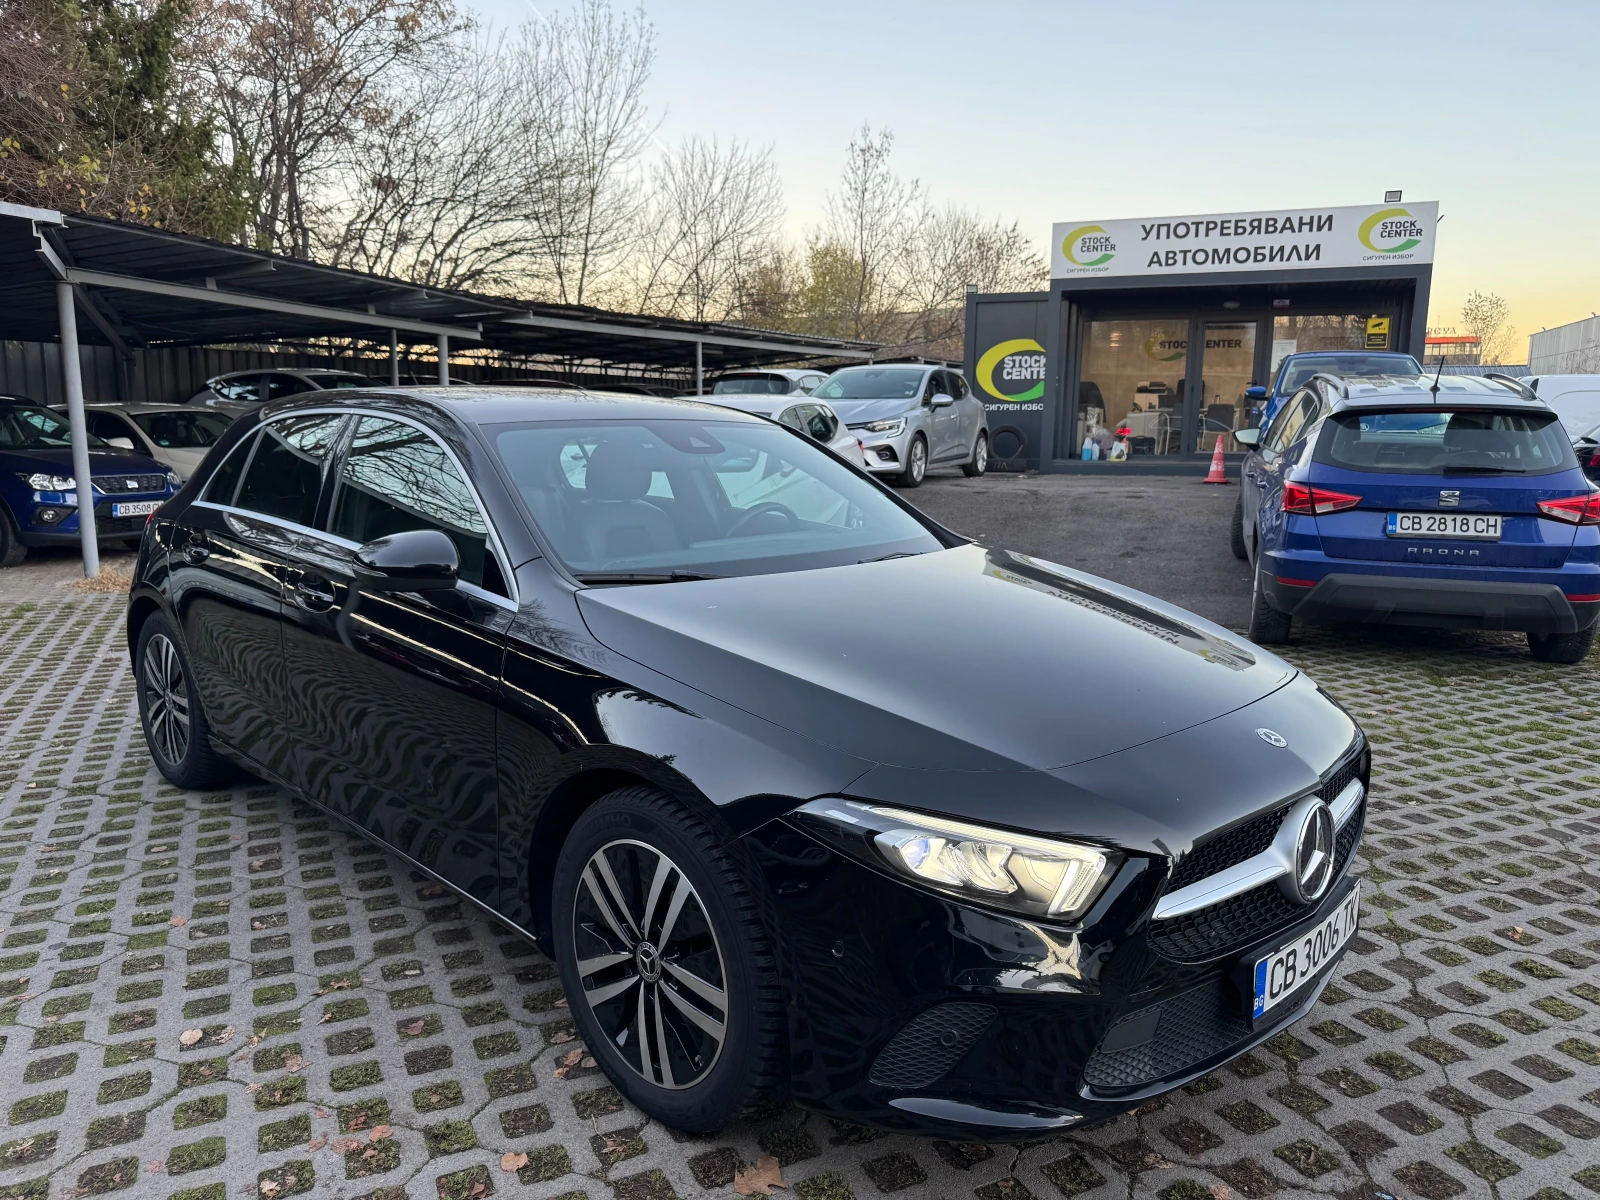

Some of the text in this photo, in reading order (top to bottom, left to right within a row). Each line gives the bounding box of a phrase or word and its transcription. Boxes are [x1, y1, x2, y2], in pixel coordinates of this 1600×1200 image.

[1140, 214, 1334, 241] УПОТРЕБЯВАНИ
[1381, 220, 1418, 230] STOCK
[1380, 228, 1423, 239] CENTER
[1081, 236, 1111, 246] STOCK
[1080, 244, 1116, 253] CENTER
[1146, 243, 1321, 268] АВТОМОБИЛИ
[1159, 339, 1242, 350] STOC ENTER
[1002, 367, 1046, 380] CENTE
[984, 403, 1044, 411] СИГУРЕН ИЗБО
[119, 505, 130, 515] CB
[131, 504, 151, 514] 3508
[1400, 515, 1498, 534] CB 2818 CH
[1407, 547, 1480, 556] ARONA
[1269, 890, 1358, 1000] CB 3006 TK
[1253, 994, 1264, 1010] BG
